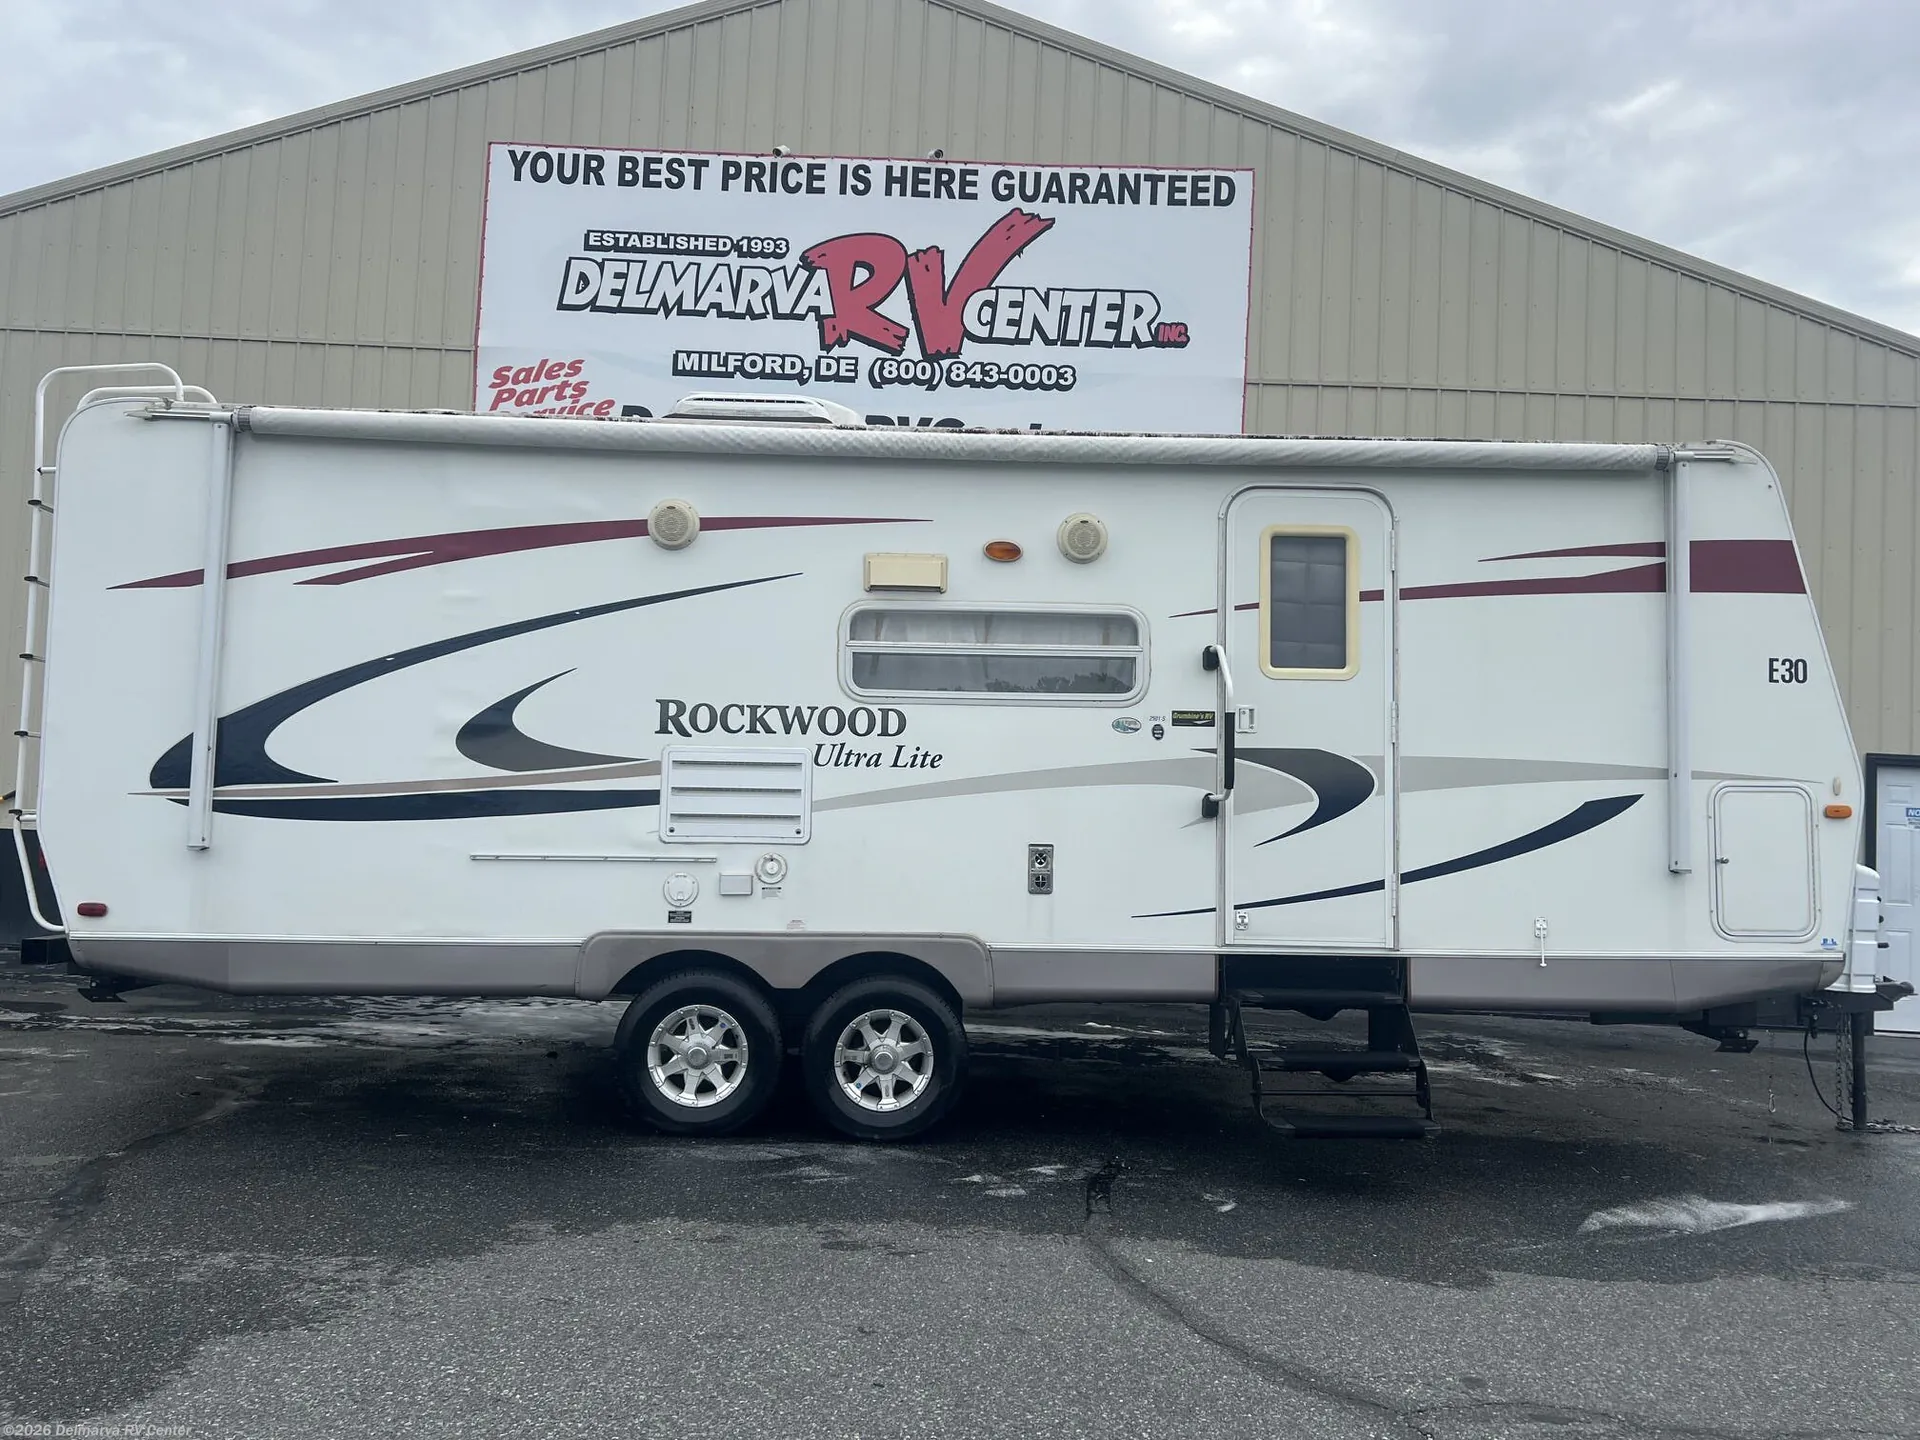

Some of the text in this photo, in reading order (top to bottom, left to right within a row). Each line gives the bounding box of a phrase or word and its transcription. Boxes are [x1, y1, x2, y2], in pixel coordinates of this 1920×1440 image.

[508, 150, 1237, 207] YOUR BEST PRICE IS HERE GUARANTEED
[586, 231, 789, 256] ESTABLISHED 1993
[558, 208, 1190, 360] DELMARVA RV CENTER INC.
[488, 358, 585, 389] Sales
[674, 351, 1076, 388] MILFORD, DE (800) 843-0003
[488, 379, 590, 411] Parts
[1768, 658, 1808, 684] E30
[654, 698, 907, 737] ROCKWOOD
[813, 742, 943, 769] Ultra Lite
